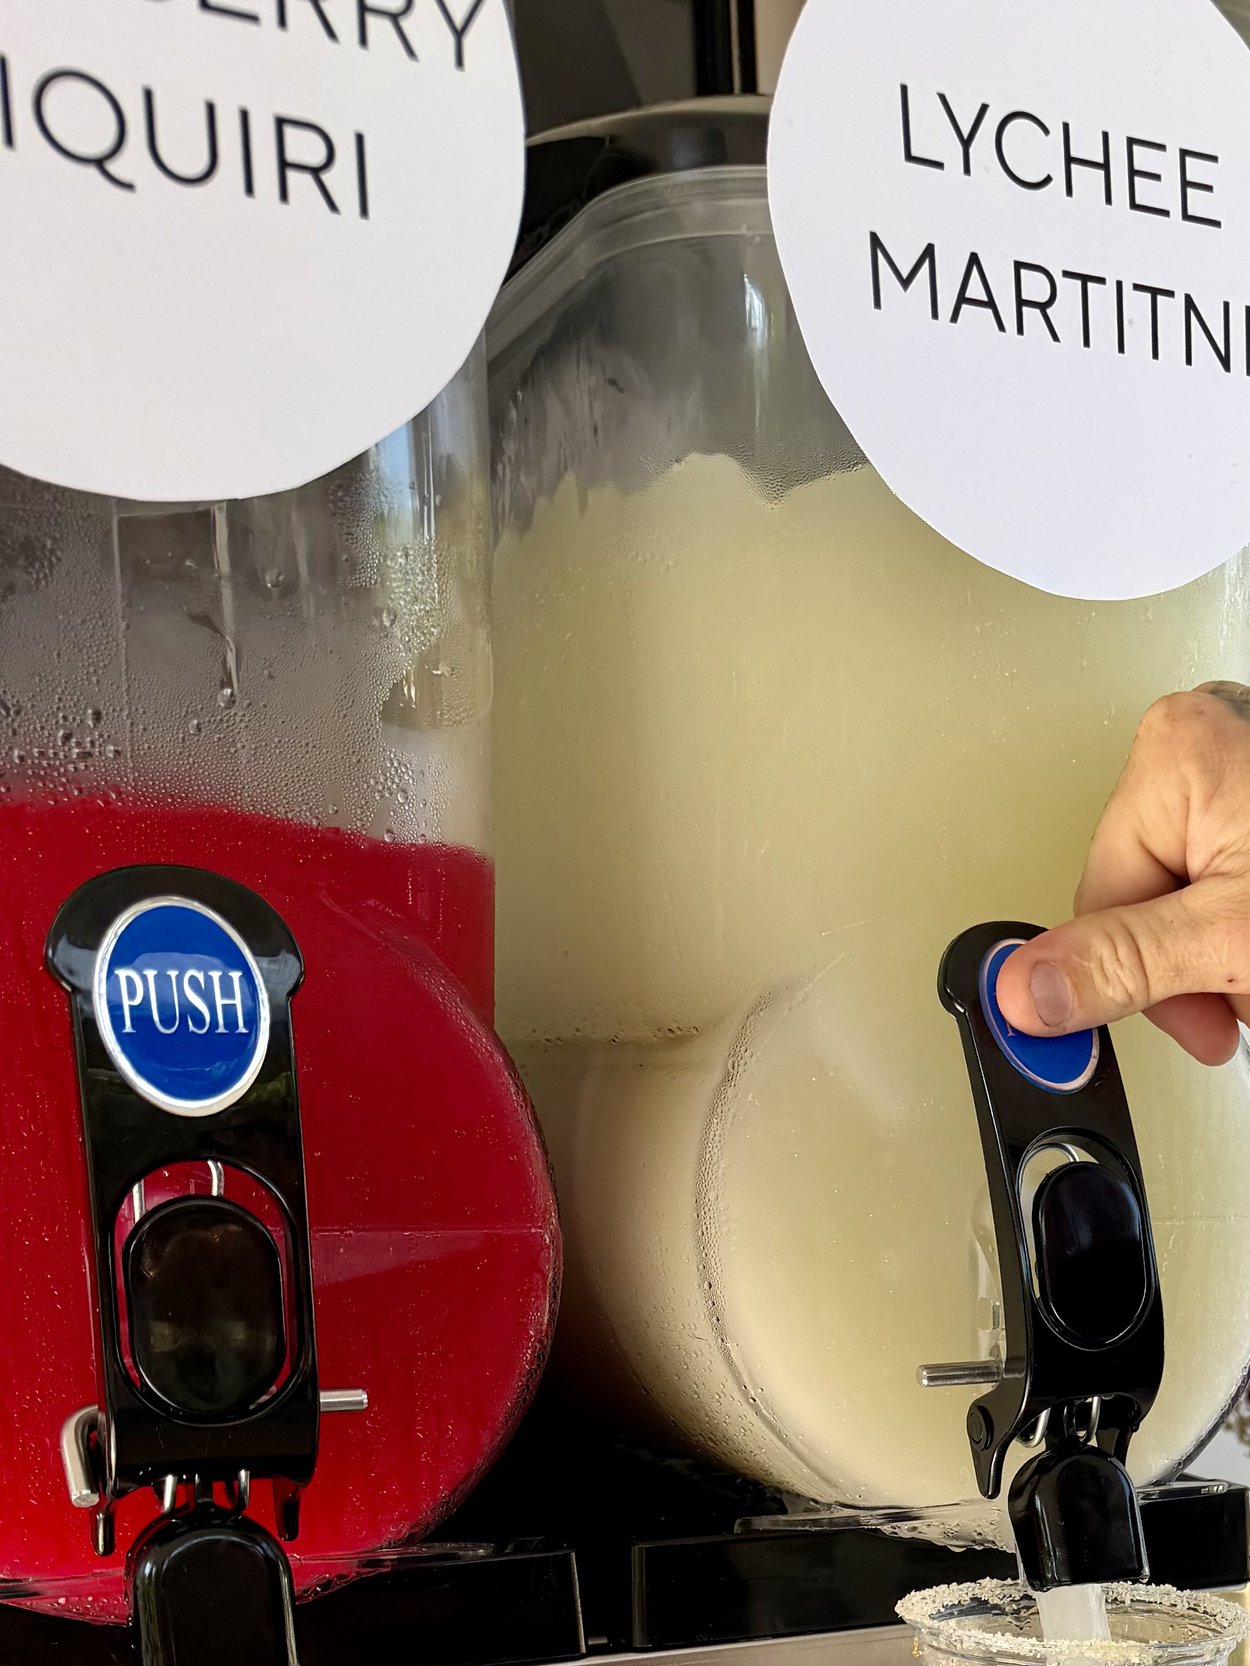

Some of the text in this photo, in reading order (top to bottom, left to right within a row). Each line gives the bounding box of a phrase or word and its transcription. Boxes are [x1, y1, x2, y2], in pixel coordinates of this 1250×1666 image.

[0, 52, 370, 220] IQUIRI
[900, 82, 1222, 229] LYCHEE
[114, 968, 249, 1035] PUSH
